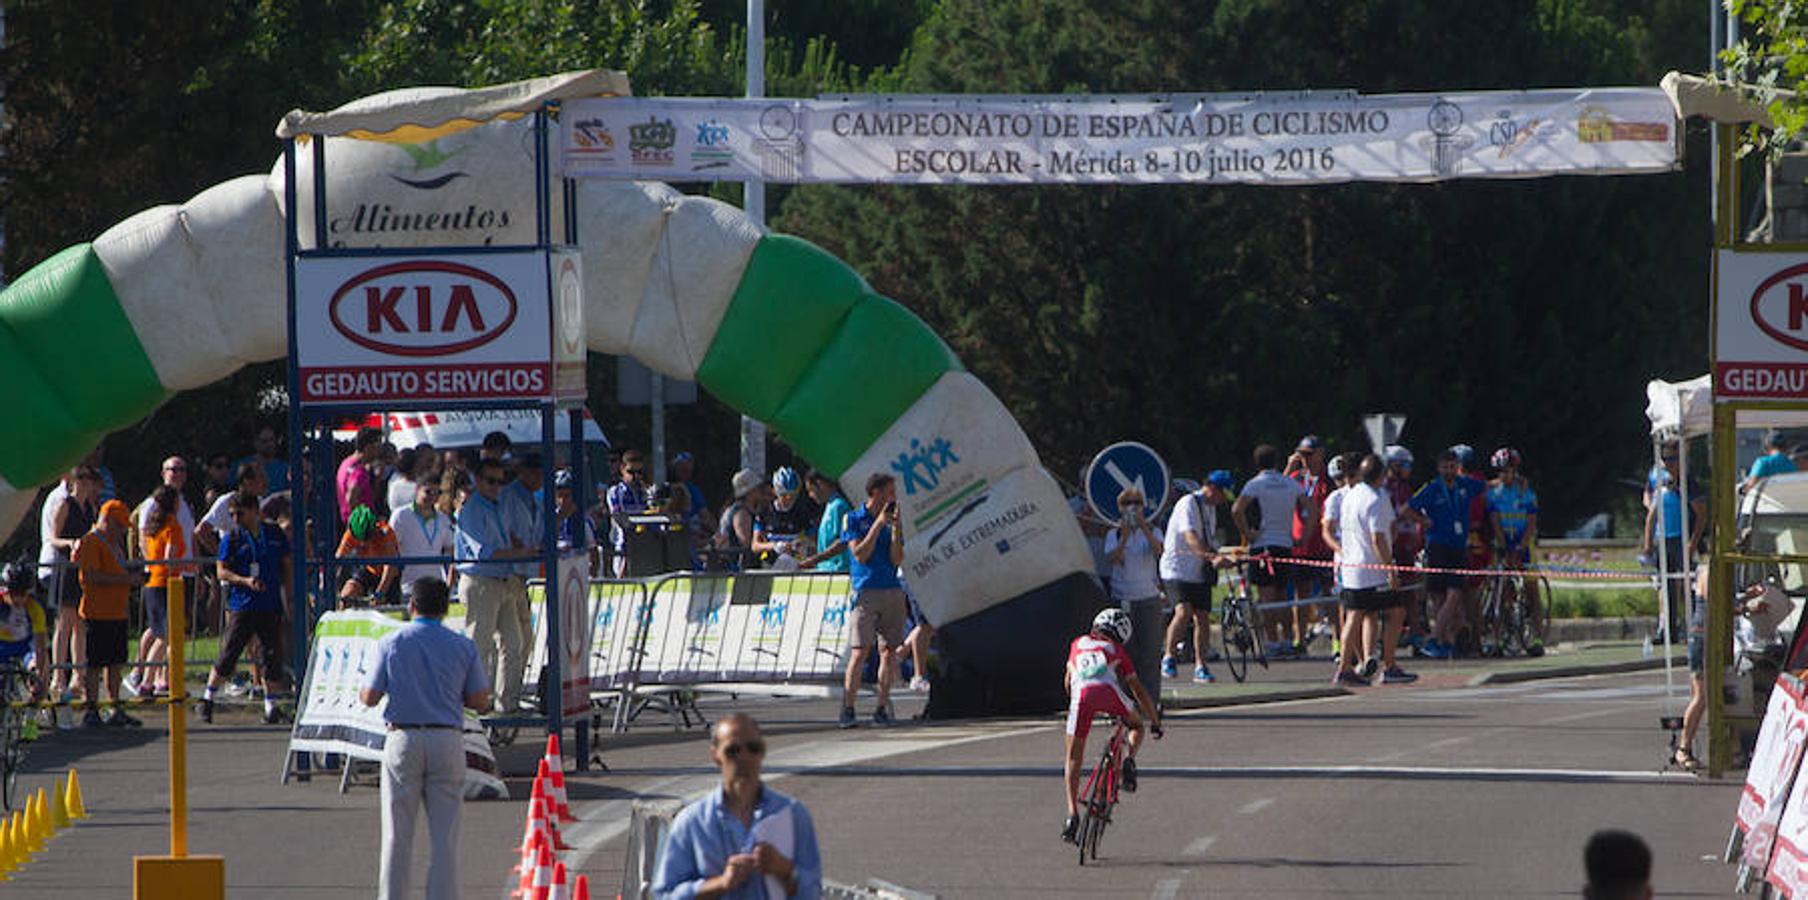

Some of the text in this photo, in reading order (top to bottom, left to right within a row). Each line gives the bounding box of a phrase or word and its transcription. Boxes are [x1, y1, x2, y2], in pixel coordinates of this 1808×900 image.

[831, 110, 1389, 137] CAMPEONATO DE ESPAÑA DE CICLISMO
[896, 150, 1024, 174] ESCOLAR
[1049, 151, 1135, 174] Mérida
[1145, 151, 1200, 174] 8-10
[1207, 150, 1265, 180] julio
[1274, 148, 1335, 172] 2016
[330, 203, 512, 234] Alimentos
[363, 285, 486, 333] KIA
[307, 373, 420, 395] GEDAUTO
[425, 368, 544, 392] SERVICIOS
[1724, 369, 1808, 392] GEDAU
